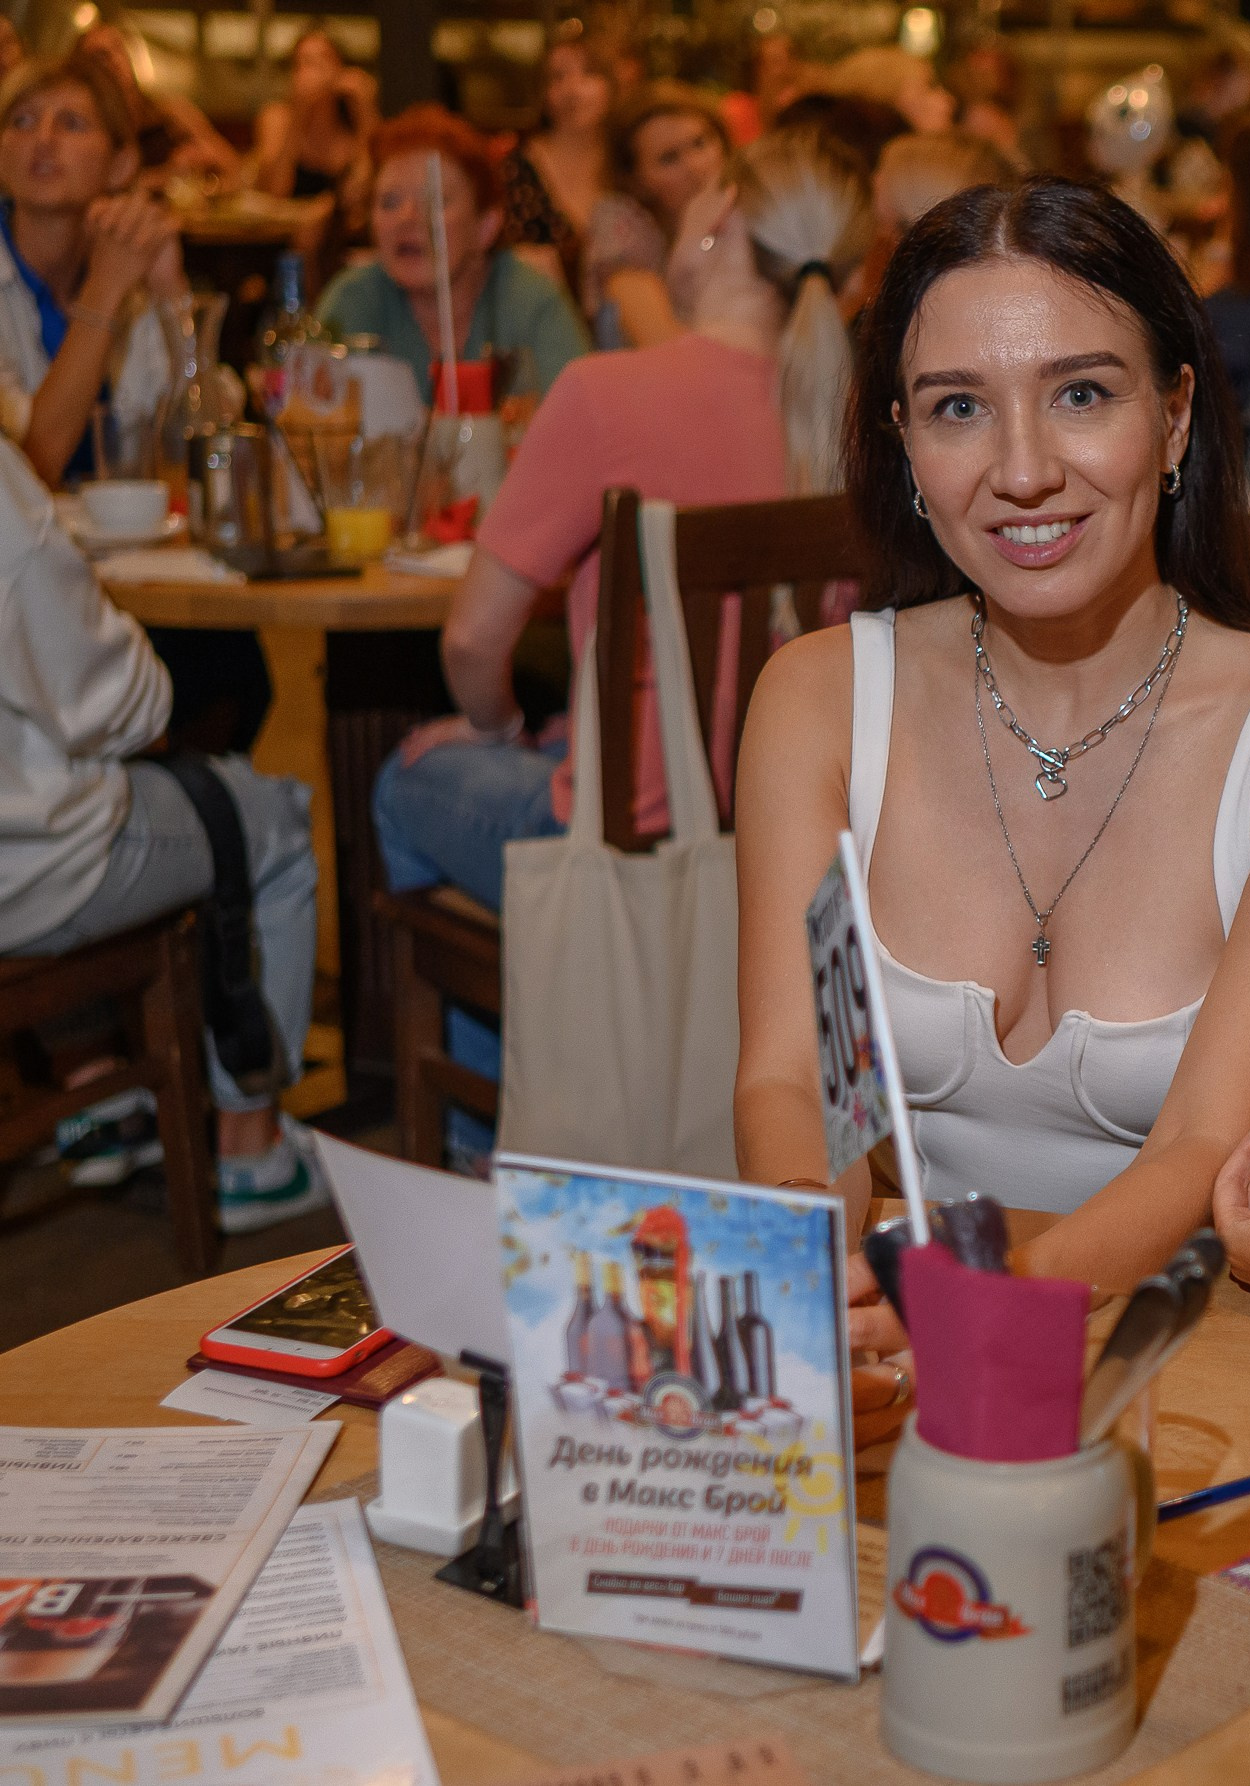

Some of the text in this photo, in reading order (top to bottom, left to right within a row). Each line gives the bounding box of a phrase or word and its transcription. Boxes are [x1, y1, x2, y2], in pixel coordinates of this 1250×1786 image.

[549, 1436, 813, 1479] День рождения
[582, 1479, 788, 1518] в Макс Брой
[32, 1533, 227, 1545] СВЕЖЕСВАРЕННОЕ
[604, 1517, 771, 1543] ПОДАРКИ ОТ МАКС БРОЙ
[570, 1536, 580, 1553] В
[583, 1537, 619, 1555] ДЕНЬ
[621, 1540, 698, 1560] РОЖДЕНИЯ
[702, 1545, 713, 1561] И
[728, 1544, 766, 1567] ДНЕЙ
[769, 1549, 814, 1568] ПОСЛЕ
